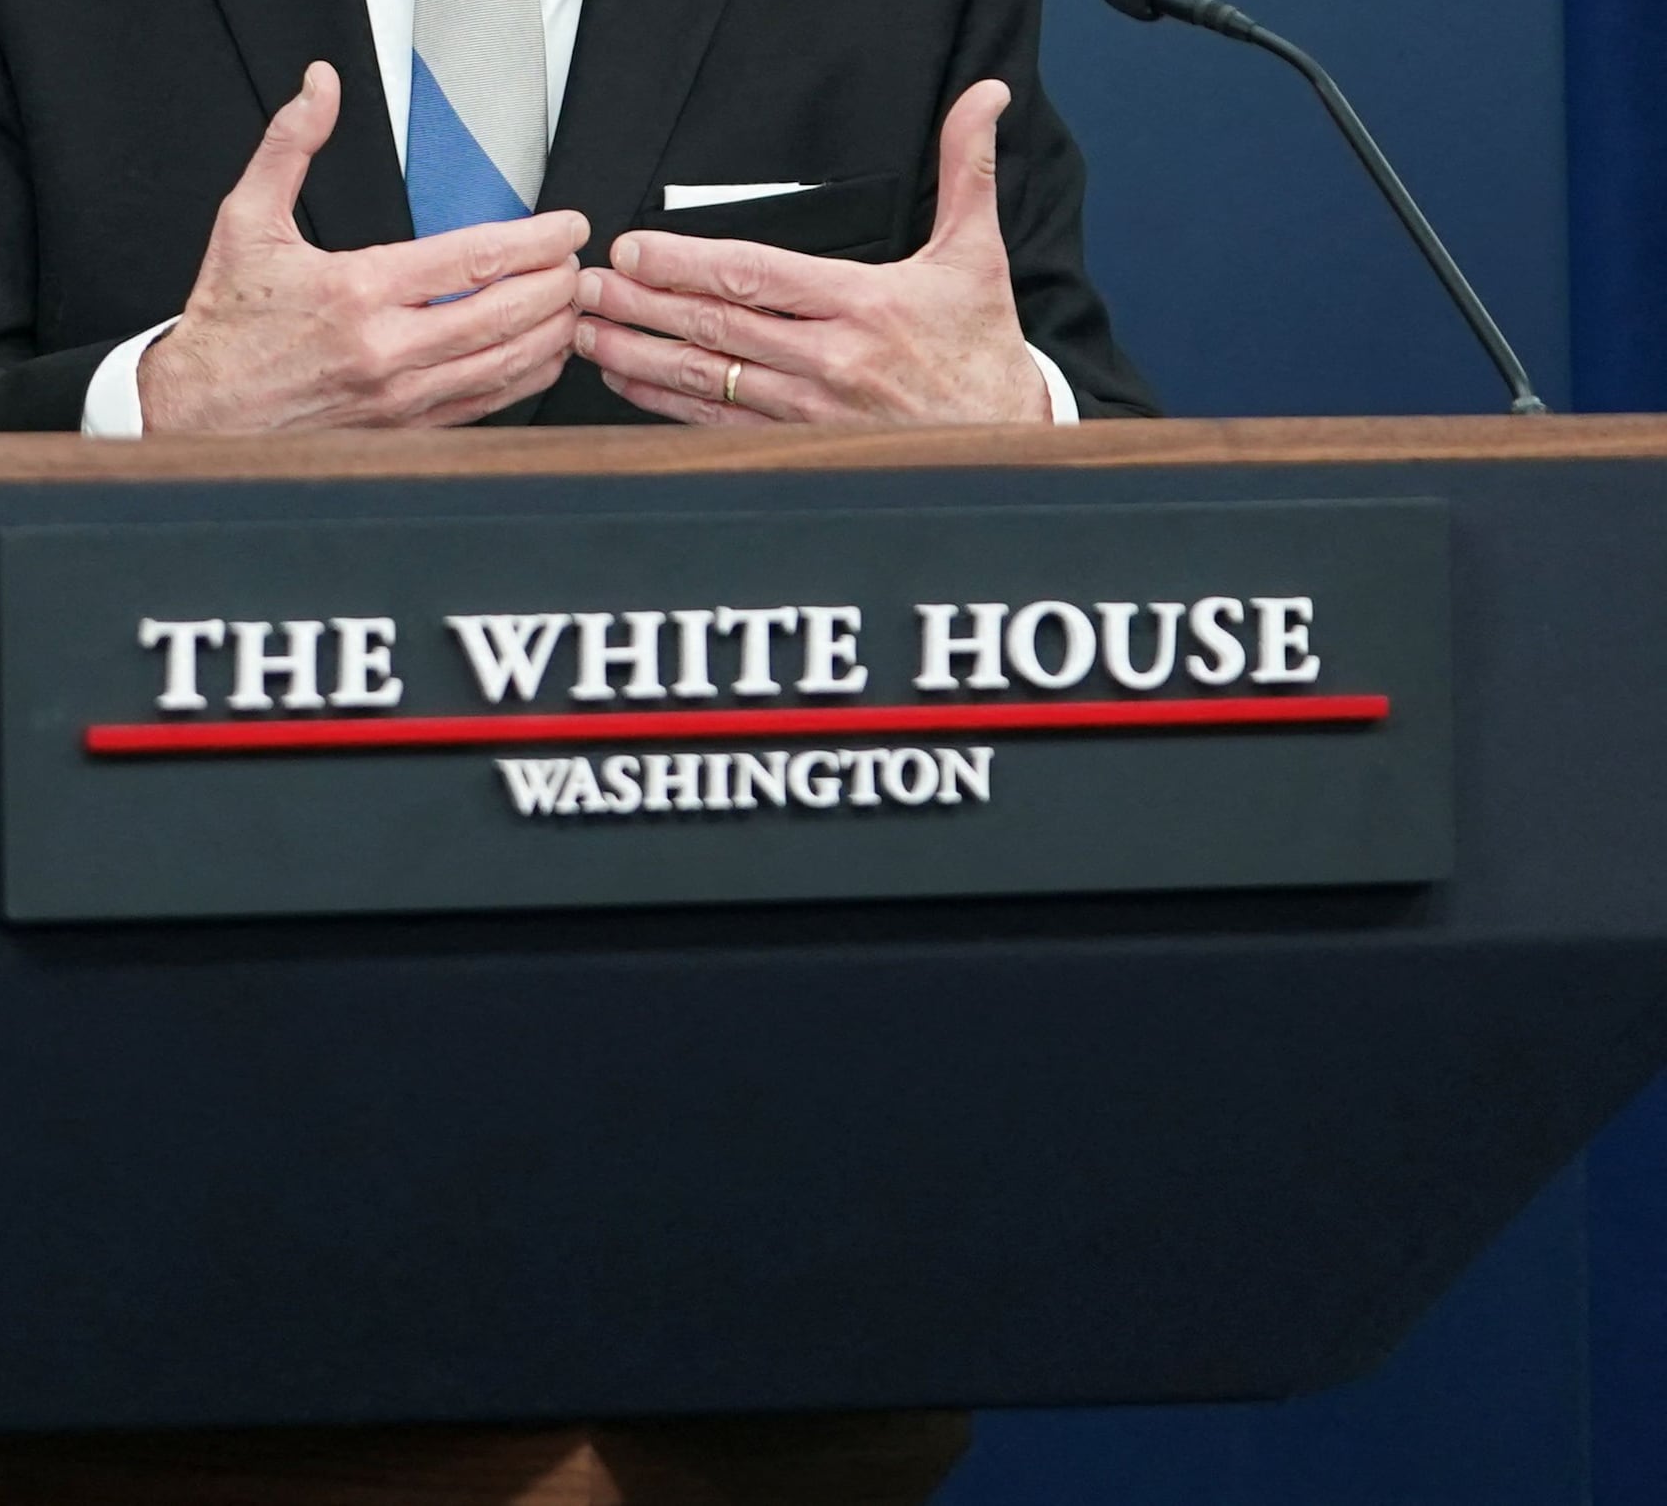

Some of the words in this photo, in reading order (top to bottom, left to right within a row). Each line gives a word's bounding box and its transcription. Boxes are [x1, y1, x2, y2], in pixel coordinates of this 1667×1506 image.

[137, 615, 405, 711] THE
[443, 604, 870, 704] WHITE
[911, 595, 1322, 691] HOUSE
[494, 745, 996, 817] WASHINGTON
